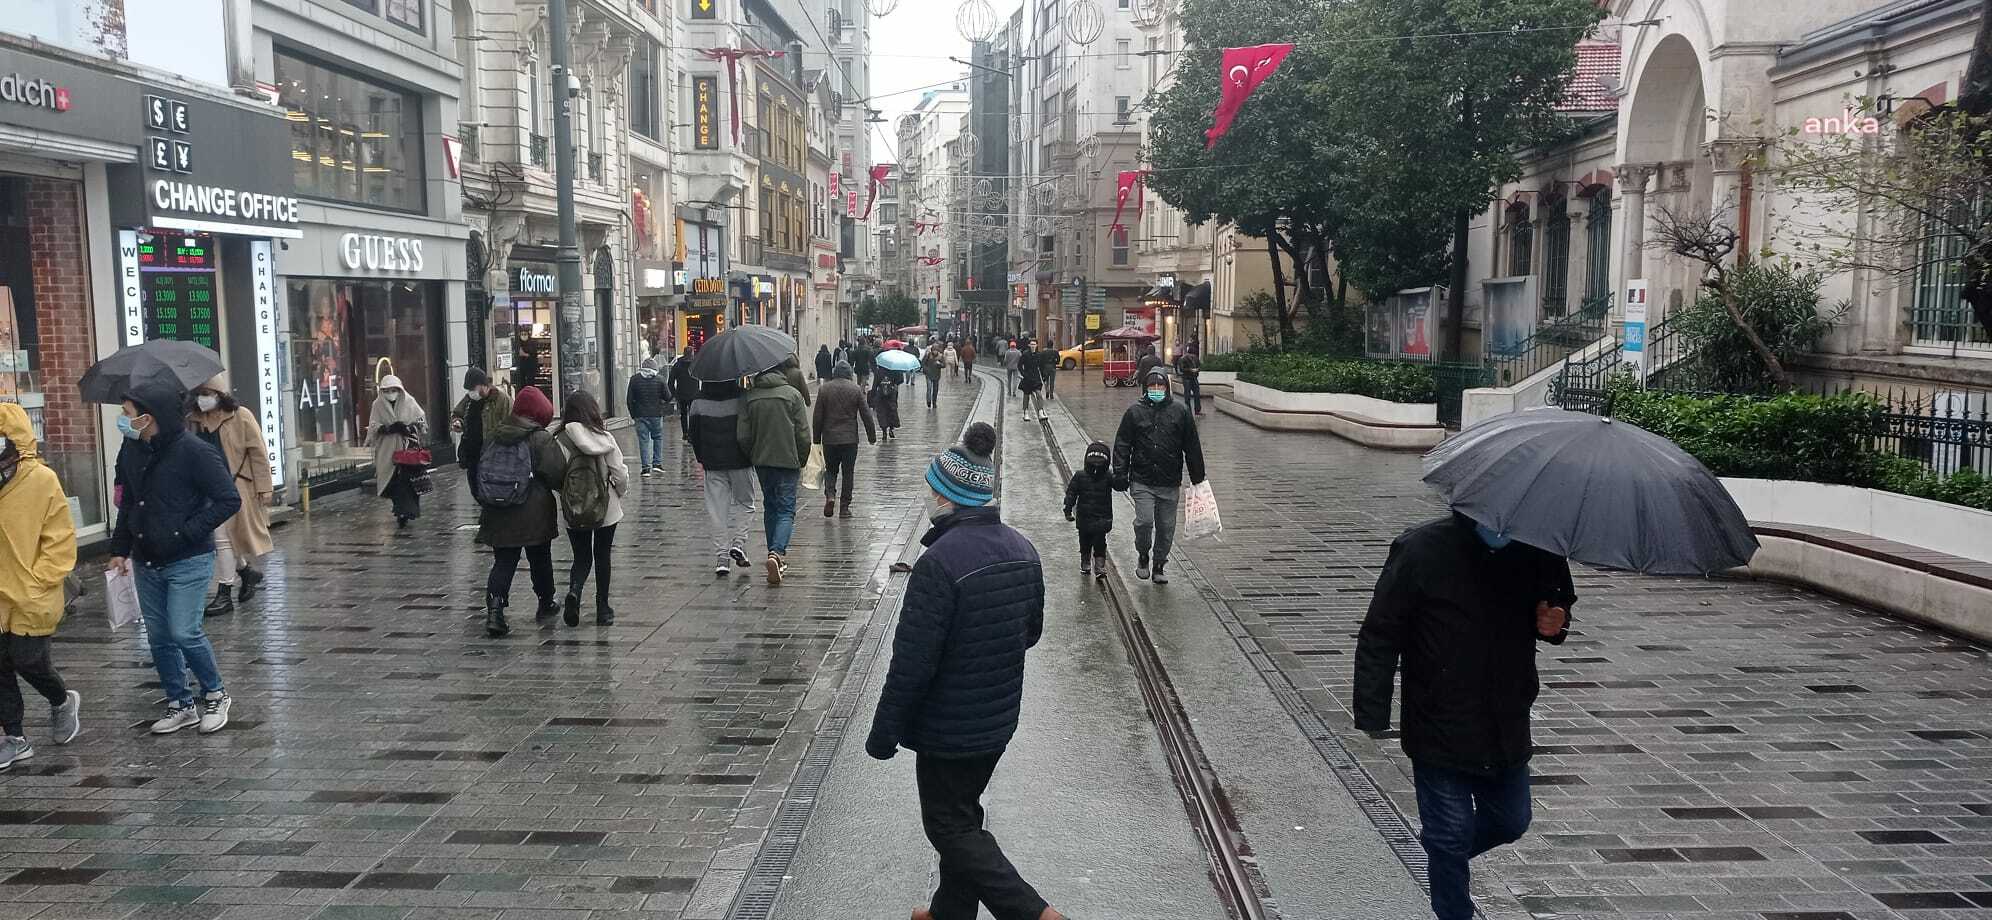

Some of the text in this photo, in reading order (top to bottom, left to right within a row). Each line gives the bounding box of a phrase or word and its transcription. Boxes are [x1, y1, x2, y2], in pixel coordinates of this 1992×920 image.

[153, 99, 186, 129] $ €
[698, 82, 709, 145] CHANGE
[156, 142, 189, 168] £ ¥
[155, 179, 299, 223] CHANGE OFFICE
[344, 233, 424, 271] GUESS
[122, 247, 140, 337] WECHS
[257, 252, 270, 334] CHANGE
[520, 267, 555, 292] flormar
[263, 353, 277, 475] EXCHAHNGE
